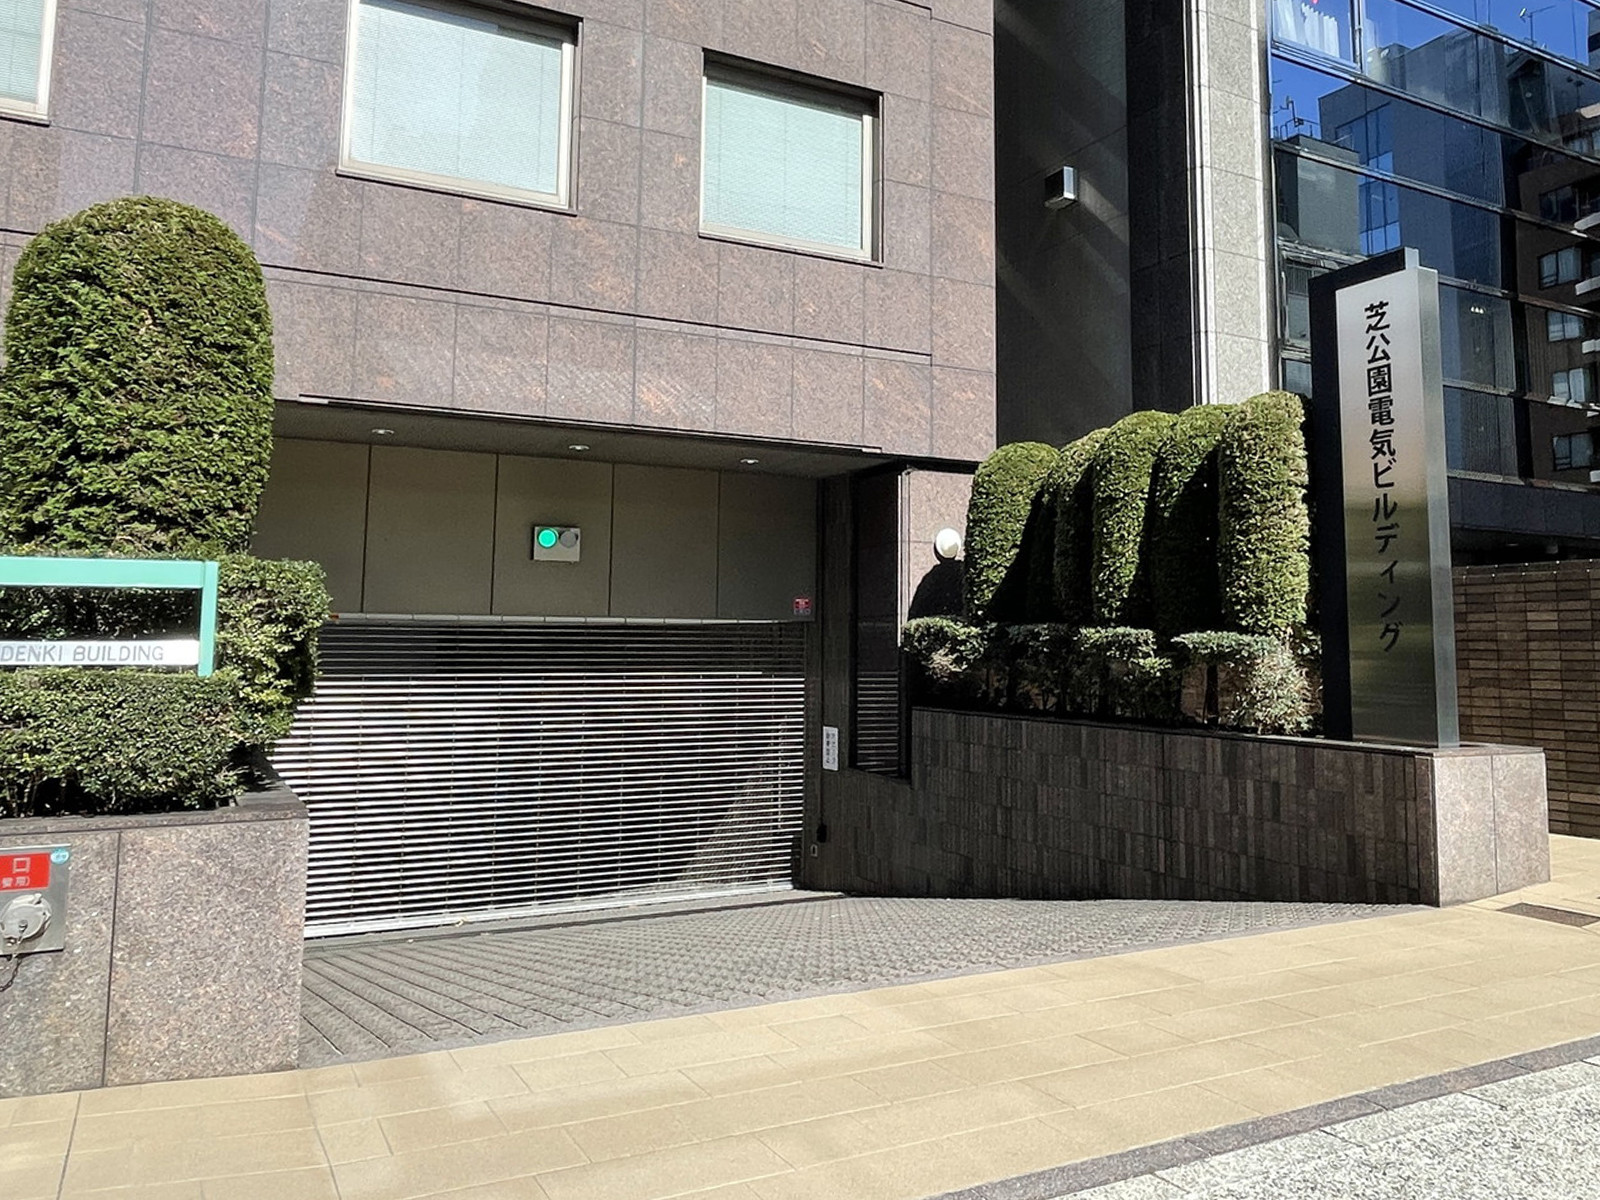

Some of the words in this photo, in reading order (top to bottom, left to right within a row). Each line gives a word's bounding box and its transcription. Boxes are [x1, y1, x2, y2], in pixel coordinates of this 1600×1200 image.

[1364, 300, 1404, 653] 芝公園電気ビルディング
[0, 645, 63, 662] DENKI
[73, 645, 165, 662] BUILDING
